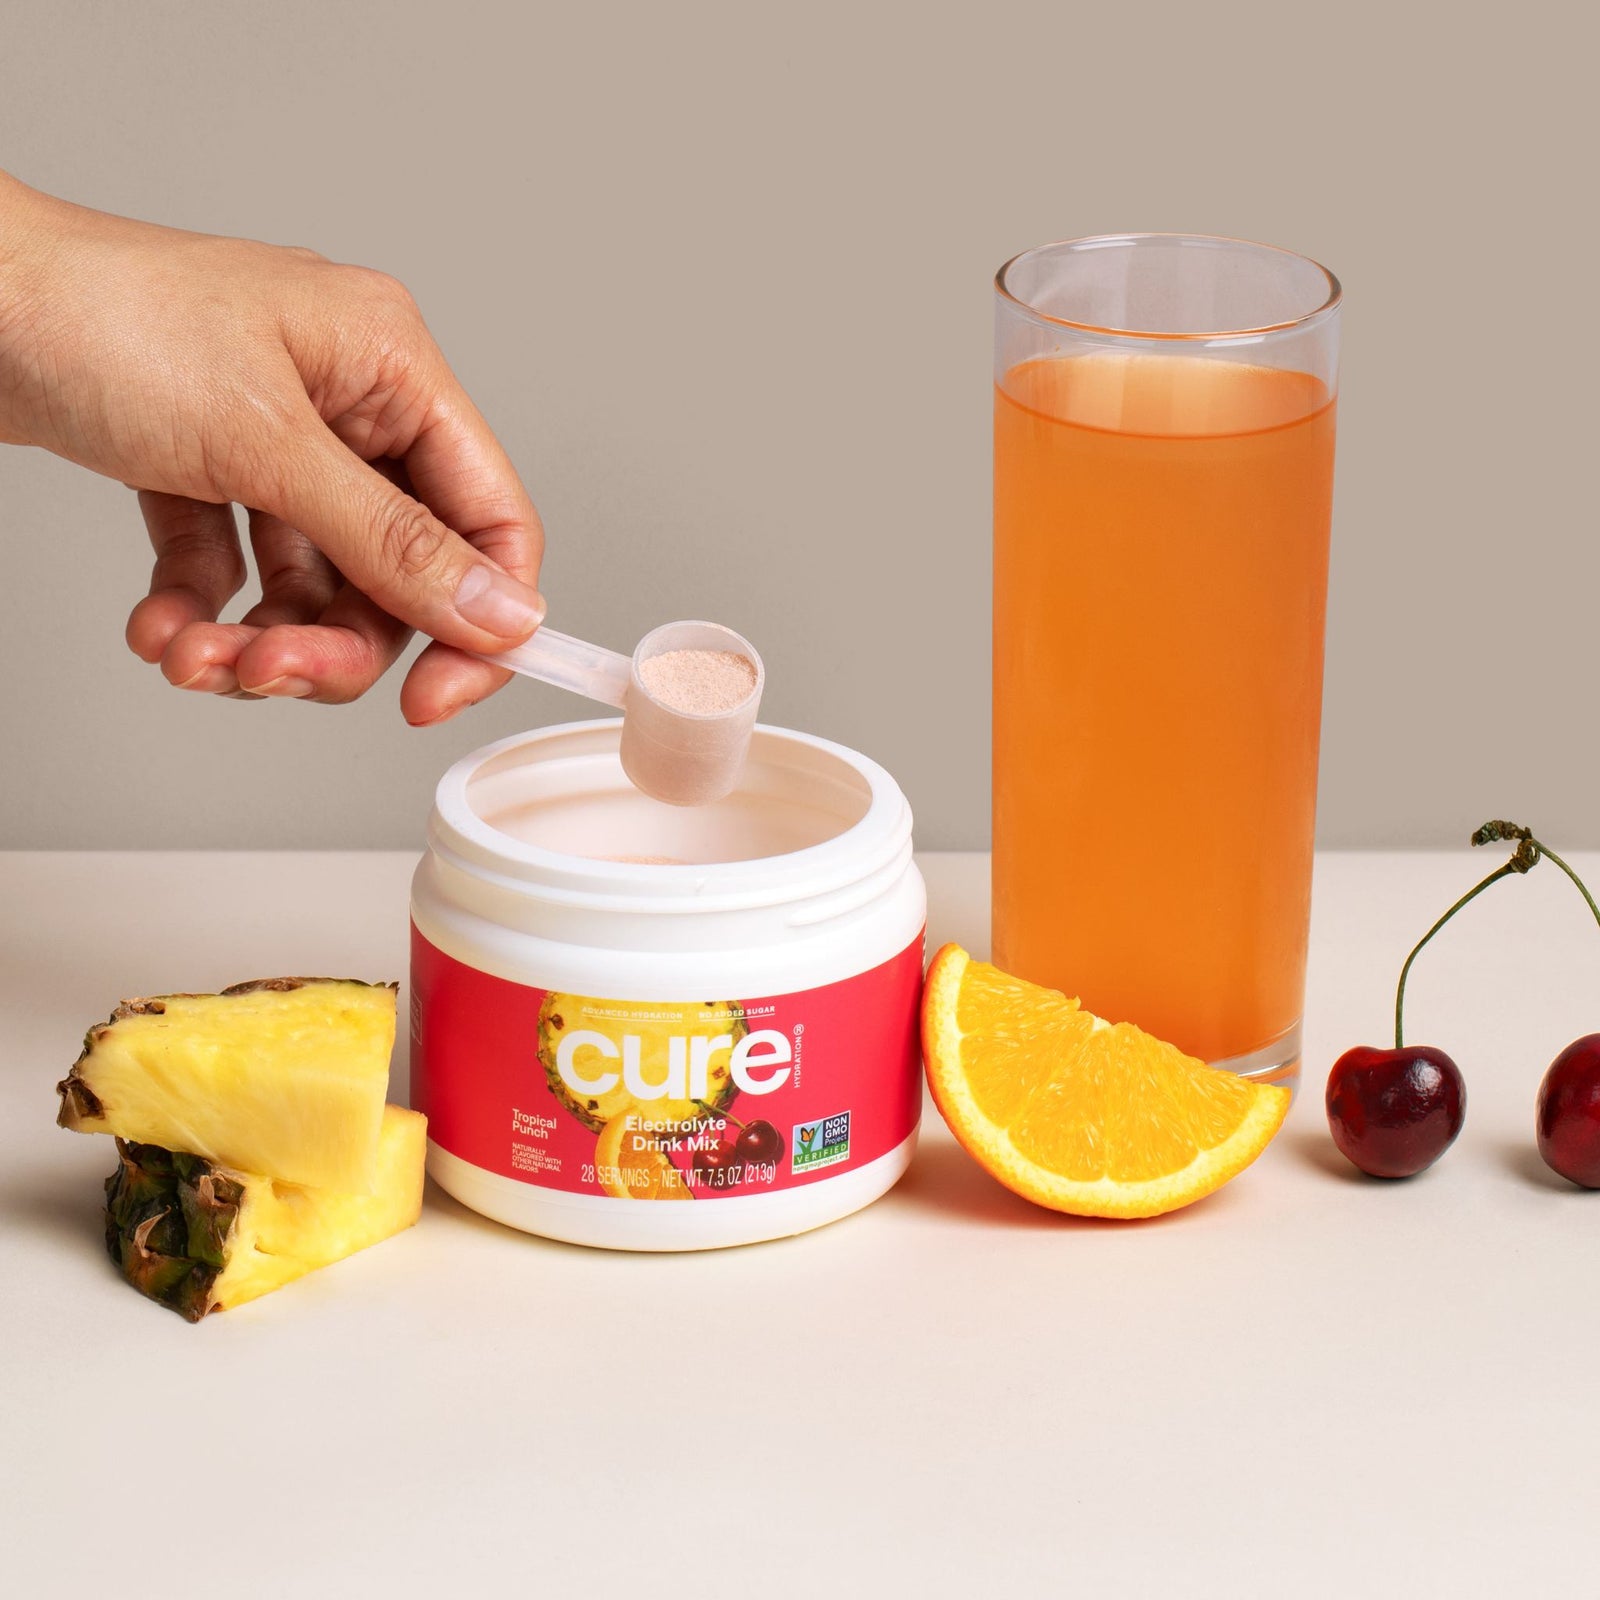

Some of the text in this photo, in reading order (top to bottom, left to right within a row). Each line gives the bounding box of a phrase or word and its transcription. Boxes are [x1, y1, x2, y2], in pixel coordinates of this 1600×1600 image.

[714, 1009, 744, 1017] ADDED
[746, 1006, 775, 1015] SUGAR
[556, 1029, 792, 1100] cure
[794, 1036, 802, 1089] HYDRATION
[512, 1108, 557, 1130] Tropical
[625, 1115, 727, 1136] Electrolyte
[825, 1115, 848, 1129] NON
[512, 1120, 548, 1139] Punch
[825, 1124, 848, 1138] GMO
[512, 1142, 546, 1156] NATURALLY
[632, 1136, 719, 1152] Drink Mix
[512, 1149, 562, 1166] FLAVORED WITH
[796, 1143, 847, 1164] VERIFIED
[512, 1155, 561, 1172] OTHER NATURAL
[512, 1162, 539, 1174] FLAVORS
[581, 1164, 594, 1182] 28
[598, 1166, 650, 1187] SERVINGS
[662, 1170, 683, 1187] NET
[686, 1168, 704, 1187] WT.
[708, 1168, 724, 1187] 7.5
[728, 1166, 742, 1185] OZ
[744, 1160, 776, 1185] (213g)
